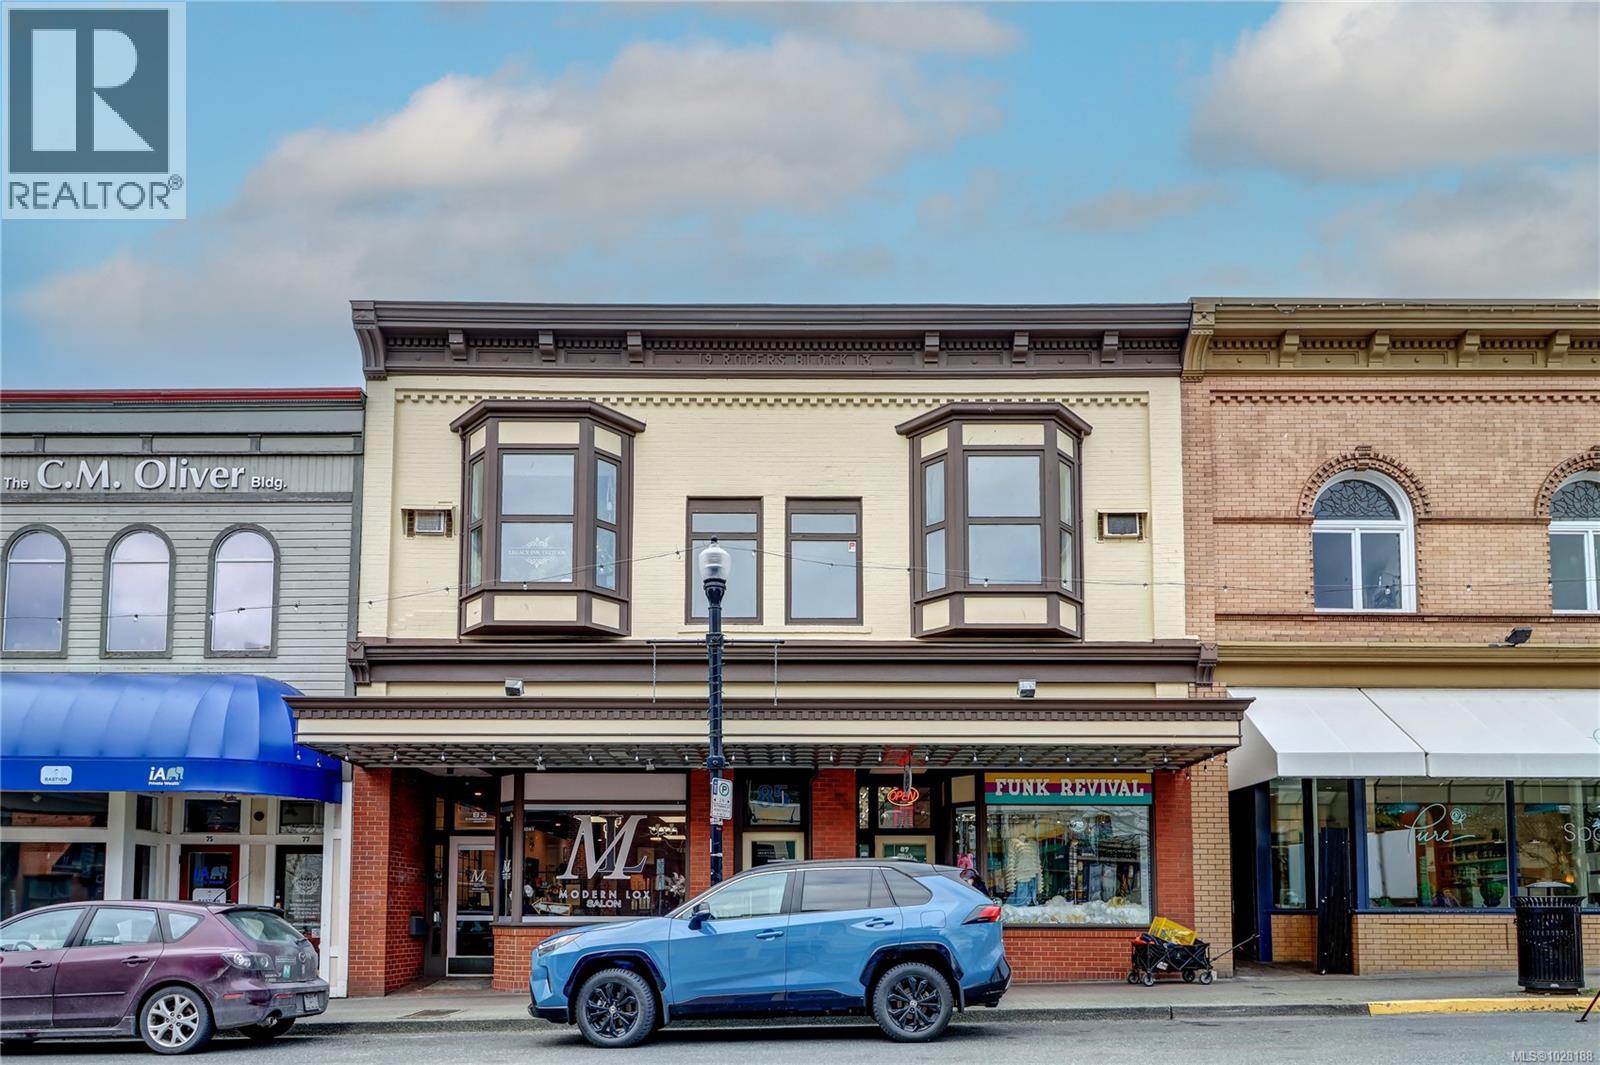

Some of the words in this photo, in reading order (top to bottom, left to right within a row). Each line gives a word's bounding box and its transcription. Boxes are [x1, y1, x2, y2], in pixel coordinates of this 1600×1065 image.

[4, 477, 30, 490] The
[37, 459, 122, 490] C.M.
[134, 456, 246, 490] Oliver
[251, 476, 288, 492] Bldg.
[149, 766, 166, 781] iA
[995, 778, 1050, 796] FUNK
[1060, 778, 1144, 797] REVIVAL
[890, 790, 916, 801] OPEN
[1404, 803, 1476, 854] Pure
[558, 890, 618, 899] MODERN
[625, 890, 651, 899] LOX
[586, 899, 622, 908] SALON
